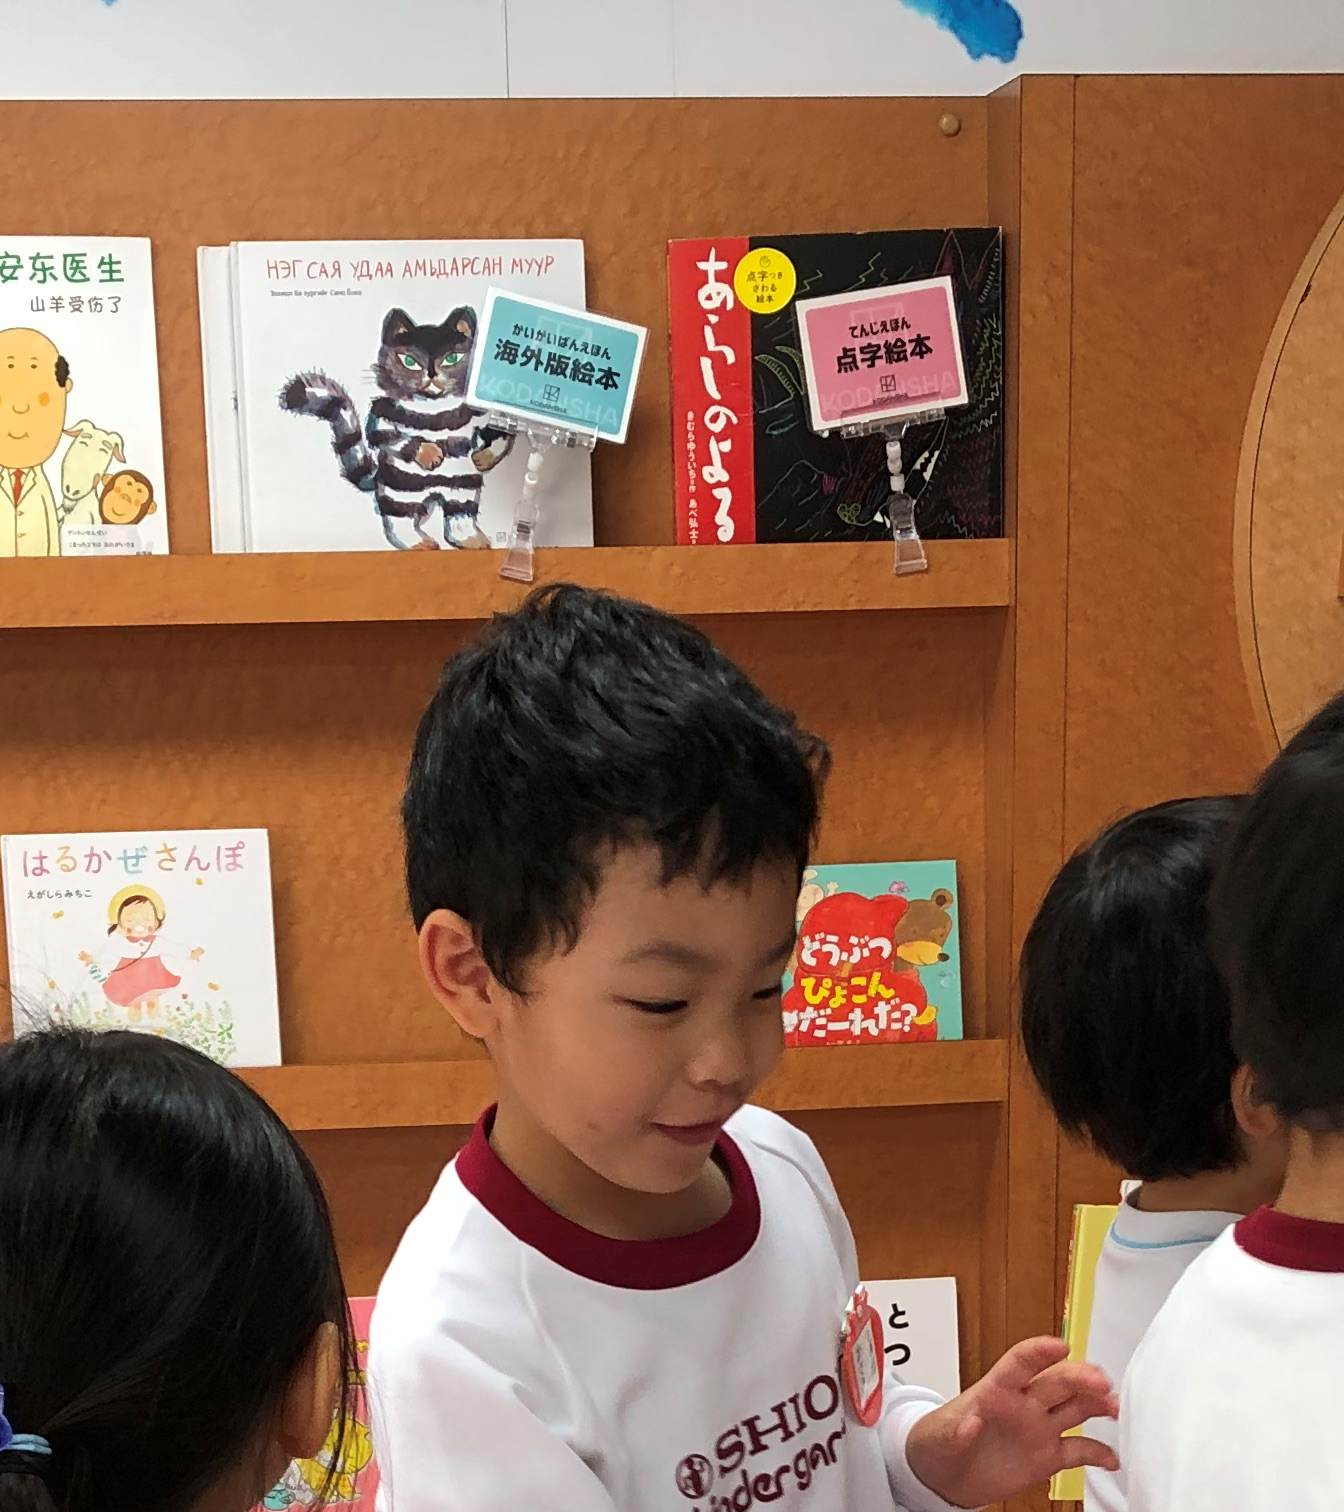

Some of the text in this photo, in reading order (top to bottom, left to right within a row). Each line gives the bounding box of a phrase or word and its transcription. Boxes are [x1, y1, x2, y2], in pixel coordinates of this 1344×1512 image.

[266, 254, 555, 281] НЭГ САЯ УДАА АМЬДАРСАН МУУР
[29, 294, 123, 315] 山羊受伤了
[755, 293, 775, 305] 絵本
[848, 316, 912, 339] てんじえほん
[494, 338, 622, 391] 海外版絵本
[835, 333, 934, 374] 点字絵本
[696, 246, 739, 543] あらしのよる
[22, 840, 246, 878] はるかぜさんぽ
[801, 931, 893, 967] どうぶつ
[800, 971, 896, 1008] ぴょこん
